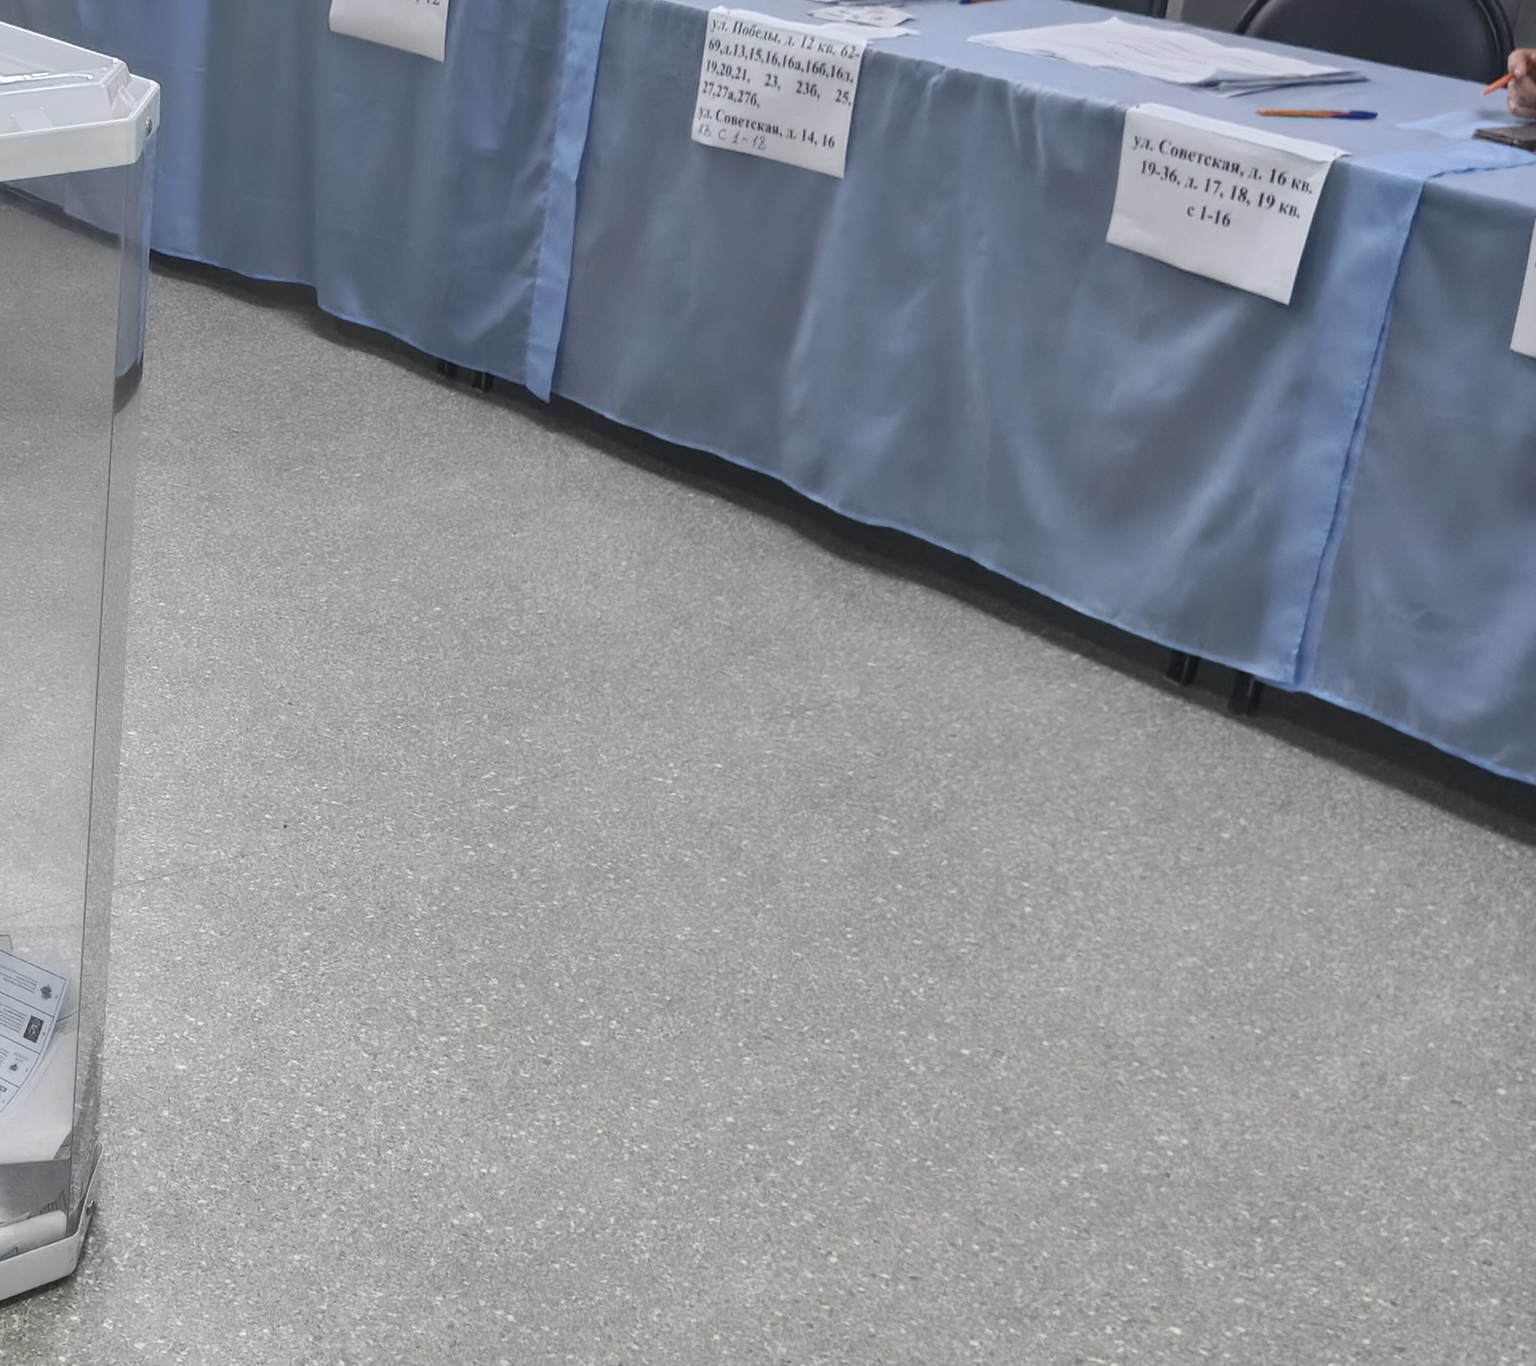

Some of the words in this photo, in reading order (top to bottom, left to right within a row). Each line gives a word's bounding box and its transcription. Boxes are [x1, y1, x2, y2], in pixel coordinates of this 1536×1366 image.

[710, 19, 728, 33] ул.
[732, 20, 781, 45] Победы,
[800, 35, 814, 50] 12
[817, 41, 836, 56] кв.
[764, 73, 781, 91] 23,
[698, 106, 713, 121] ул.
[715, 109, 783, 138] Советская,
[801, 129, 818, 147] 14,
[822, 133, 835, 149] 16
[1132, 135, 1153, 151] ул.
[1158, 139, 1245, 177] Советская,
[1247, 166, 1262, 181] д.
[1269, 168, 1287, 186] 16
[1291, 177, 1313, 194] кв.
[1140, 159, 1181, 187] 19-36,
[1184, 176, 1198, 190] д.
[1204, 177, 1224, 199] 17,
[1230, 184, 1251, 206] 18,
[1257, 191, 1275, 210] 19
[1278, 202, 1300, 219] кв.
[1186, 205, 1195, 217] с
[1199, 204, 1232, 228] 1-16
